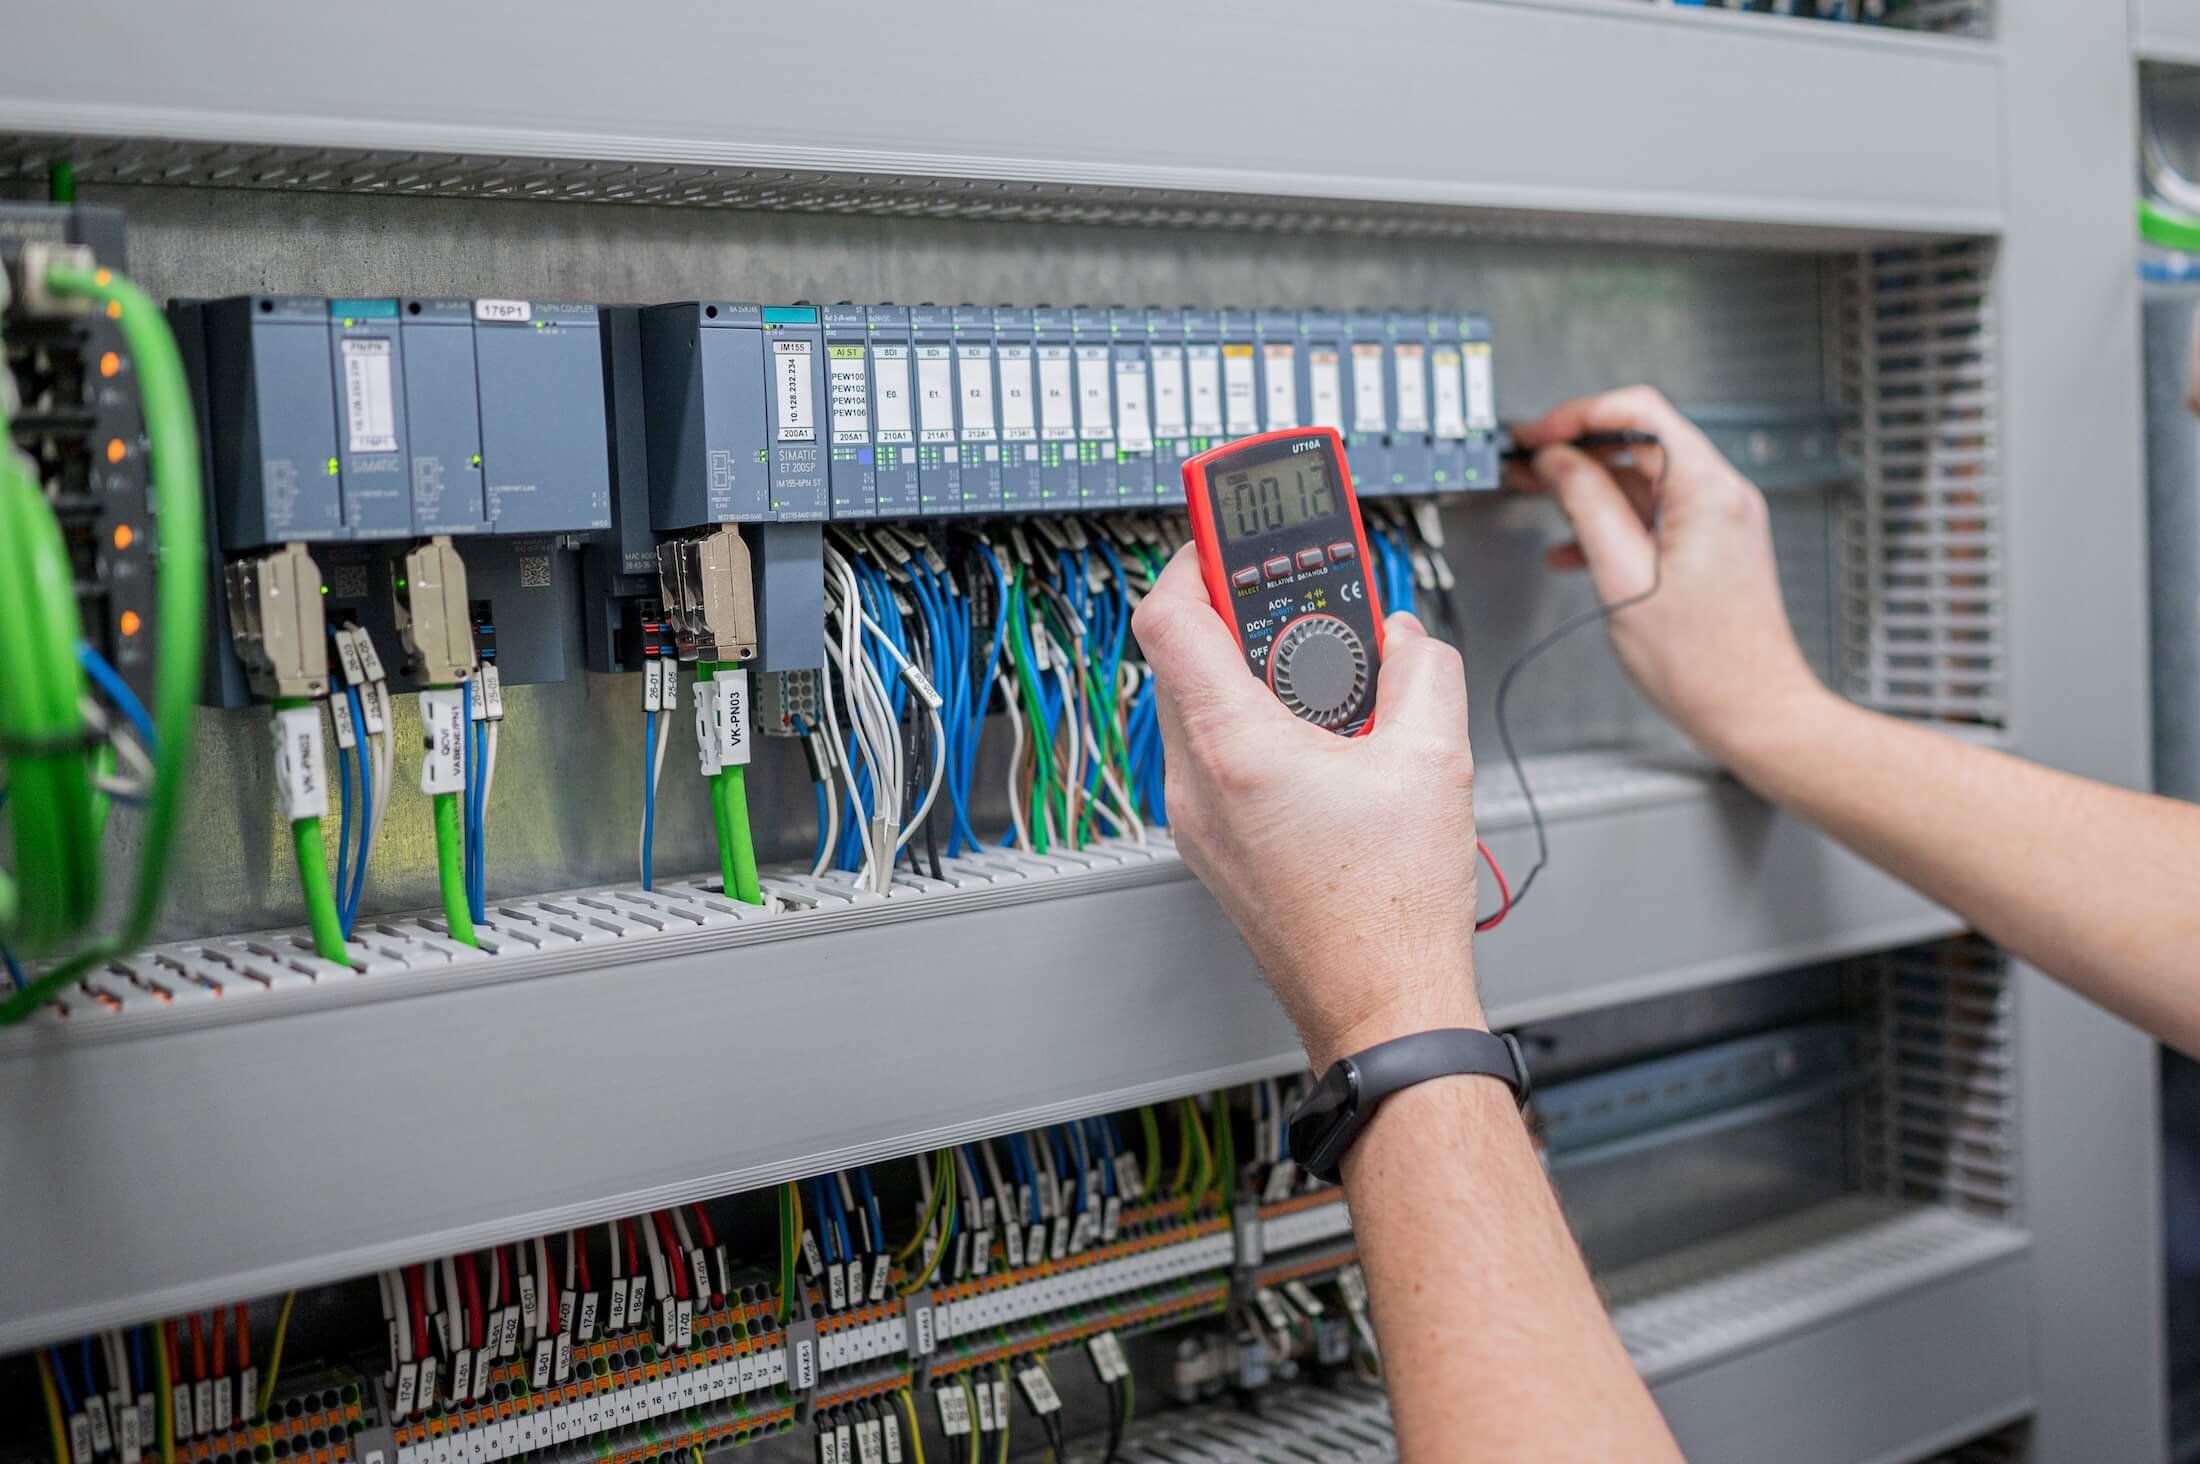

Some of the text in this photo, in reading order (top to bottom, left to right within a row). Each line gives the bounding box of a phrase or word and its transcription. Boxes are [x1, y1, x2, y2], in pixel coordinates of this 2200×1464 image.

[483, 305, 523, 317] 176P1
[780, 343, 805, 351] IM155
[836, 348, 845, 356] AI
[831, 373, 865, 381] PEW100
[788, 358, 798, 423] 10.128.232.234
[832, 385, 865, 393] PEW102
[832, 397, 866, 405] PEW104
[833, 409, 867, 417] PEW106
[783, 429, 808, 438] 200A1
[839, 433, 863, 441] 205A1
[883, 432, 907, 440] 210A1
[927, 431, 949, 439] 211A1
[1292, 439, 1321, 454] UT10A
[778, 449, 817, 461] SIMATIC
[780, 463, 817, 473] ET 200SP
[624, 552, 640, 561] MAC
[1297, 567, 1328, 581] DATA HOLD
[1266, 576, 1294, 589] RELATIVE
[1237, 586, 1260, 598] SELECT
[1340, 580, 1362, 602] CE
[1250, 645, 1269, 659] OFF
[488, 676, 500, 705] 25-05
[649, 673, 659, 699] 26-01
[730, 691, 741, 747] VK-PN03
[614, 1292, 624, 1317] 18-07
[583, 1304, 595, 1329] 17-04
[681, 1312, 690, 1336] 17-02
[505, 1318, 517, 1344] 18-02
[458, 1363, 469, 1390] 17-01
[400, 1376, 413, 1402] 17-01
[440, 1454, 446, 1462] 3
[457, 1449, 463, 1457] 4
[475, 1445, 481, 1453] 5
[491, 1440, 498, 1448] 6
[508, 1435, 515, 1444] 7
[525, 1431, 531, 1439] 8
[542, 1426, 548, 1435] 9
[556, 1422, 567, 1432] 10
[572, 1418, 582, 1427] 11
[588, 1413, 599, 1423] 12
[604, 1409, 615, 1418] 13
[620, 1404, 631, 1414] 14
[636, 1400, 647, 1409] 15
[652, 1396, 662, 1405] 16
[667, 1391, 677, 1401] 17
[683, 1388, 693, 1397] 18
[698, 1383, 708, 1392] 19
[712, 1379, 724, 1389] 20
[727, 1376, 738, 1385] 21
[742, 1372, 753, 1381] 22
[757, 1368, 768, 1377] 23
[772, 1364, 782, 1374] 24
